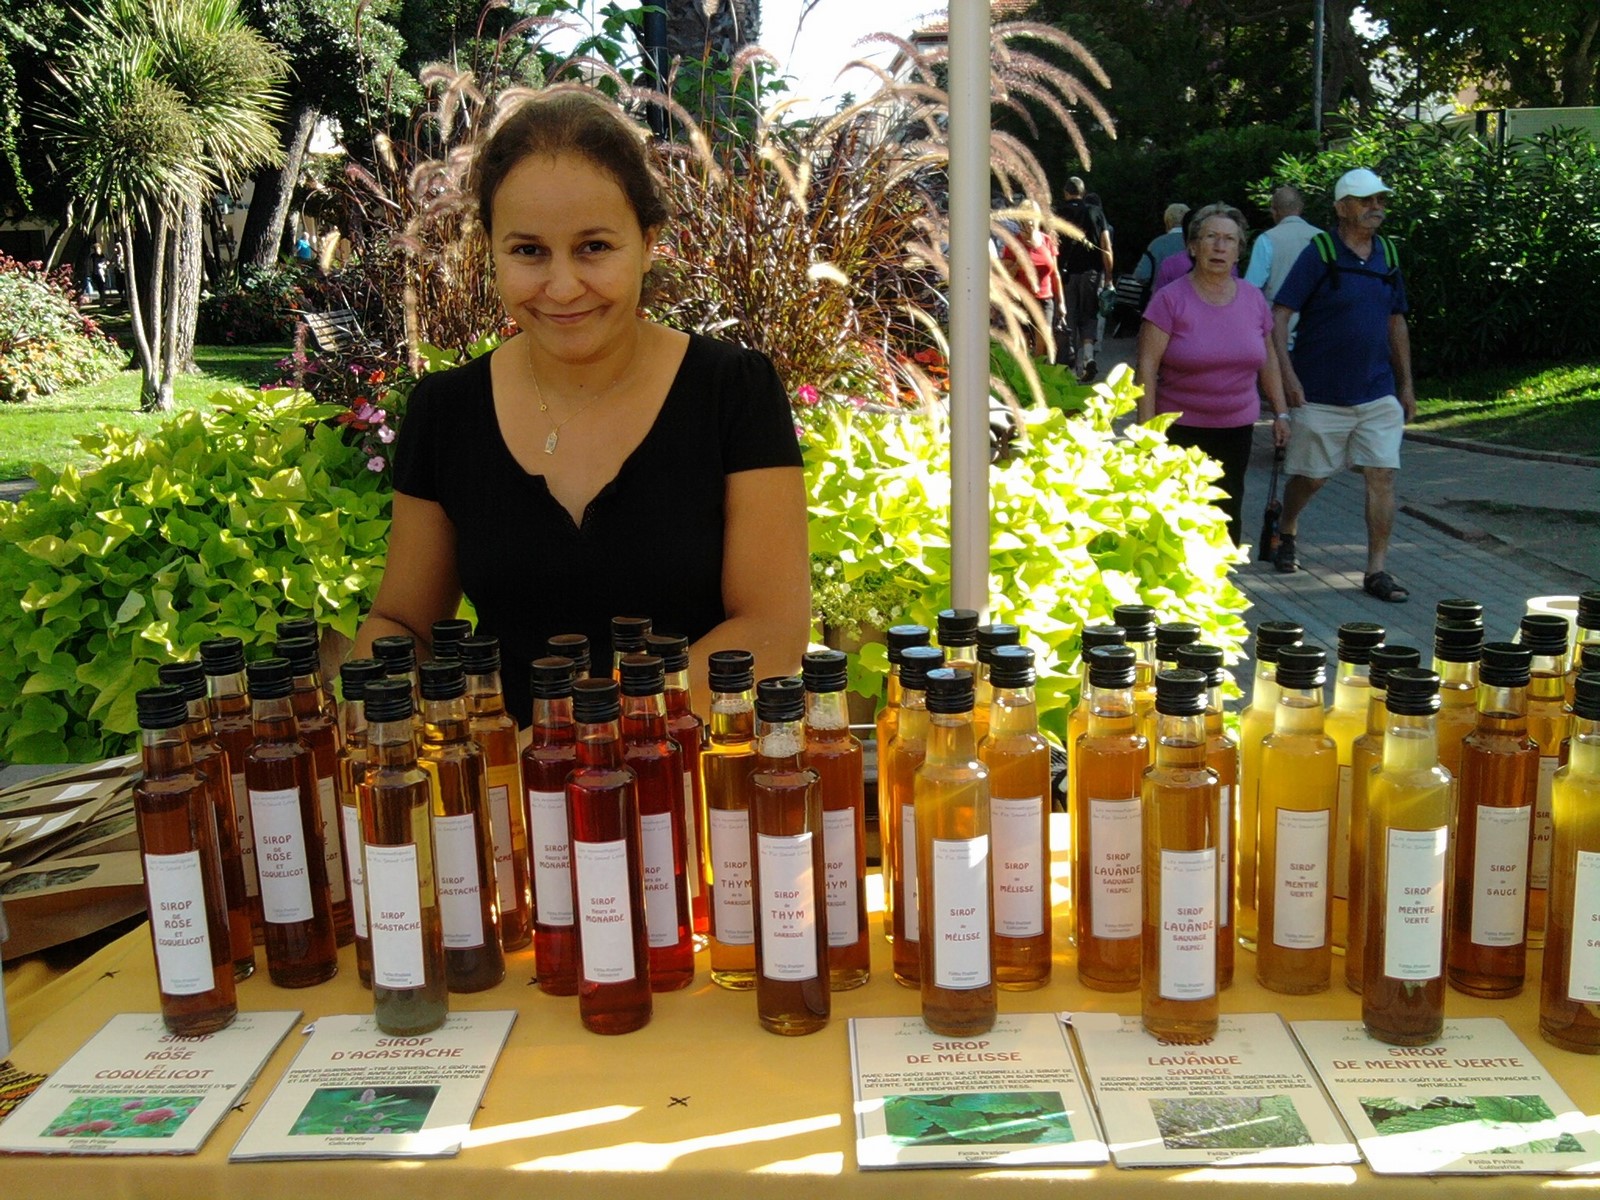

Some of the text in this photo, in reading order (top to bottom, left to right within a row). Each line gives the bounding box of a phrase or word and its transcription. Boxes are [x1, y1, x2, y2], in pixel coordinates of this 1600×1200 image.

[1536, 811, 1550, 819] SIR
[262, 834, 292, 845] SIROP
[544, 844, 569, 852] SIROP
[266, 852, 293, 861] ROSE
[1106, 853, 1131, 861] SIROP
[723, 861, 748, 869] SIROP
[1004, 862, 1030, 870] SIROP
[1289, 863, 1316, 871] SIROP
[1490, 864, 1517, 872] SIROP
[261, 868, 304, 878] COQUELICOT
[645, 866, 661, 874] ROP
[1094, 864, 1141, 876] LAVANDE
[721, 879, 752, 888] THYM
[1102, 877, 1135, 885] SAUVAGE
[1285, 880, 1319, 889] MENTHE
[1000, 884, 1034, 893] MÉLISSE
[1404, 887, 1432, 895] SIROP
[1486, 888, 1518, 896] SAUGE
[1289, 890, 1313, 898] VERTE
[160, 900, 193, 911] SIROP
[590, 897, 616, 905] SIROP
[950, 908, 976, 916] SIROP
[1177, 908, 1204, 916] SIROP
[1398, 906, 1435, 914] MENTHE
[380, 911, 406, 920] SIROP
[586, 914, 625, 923] MONARDE
[771, 910, 805, 920] THYM
[164, 918, 193, 929] ROSE
[1164, 920, 1214, 932] LAVANDE
[158, 935, 205, 946] COQUELICOT
[945, 932, 980, 942] MÉLISSE
[157, 1034, 215, 1043] SIROP
[375, 1037, 433, 1048] SIROP
[1158, 1037, 1215, 1047] SIROP
[932, 1040, 990, 1050] SIROP
[144, 1051, 196, 1060] ROSE
[330, 1048, 463, 1060] D'AGASTACHE
[1388, 1047, 1448, 1057] SIROP
[906, 1052, 1022, 1064] DE MÉLISSE
[1148, 1056, 1242, 1066] LAVANDE
[1332, 1058, 1524, 1070] DE MENTHE VERTE
[94, 1070, 214, 1079] COQUELICOT
[1167, 1068, 1232, 1076] SAUVAGE
